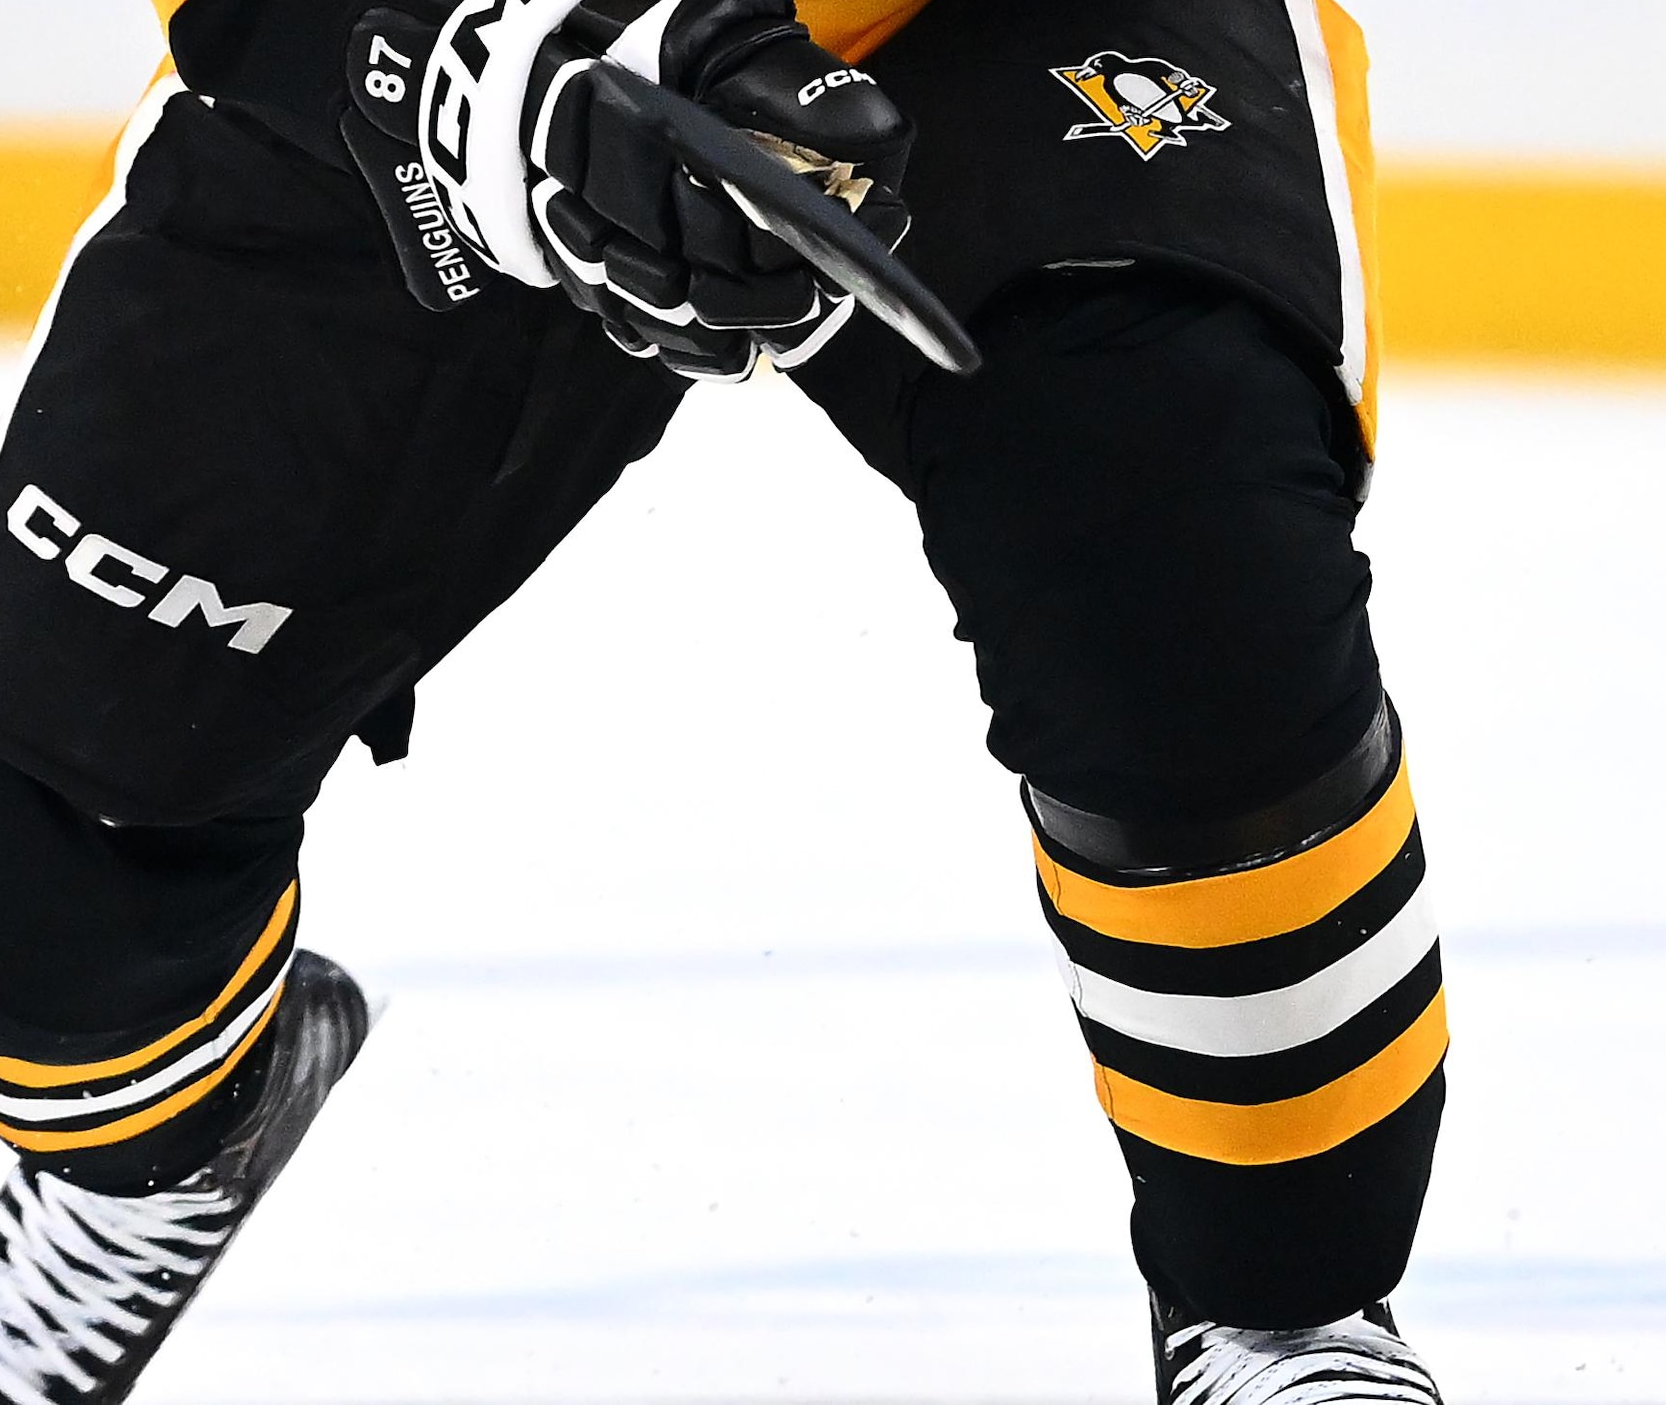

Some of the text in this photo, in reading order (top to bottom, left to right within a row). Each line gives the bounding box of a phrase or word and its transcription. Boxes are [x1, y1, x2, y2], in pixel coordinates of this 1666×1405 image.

[364, 34, 412, 103] 87
[394, 161, 481, 303] PENGUINS
[7, 483, 294, 655] CCM
